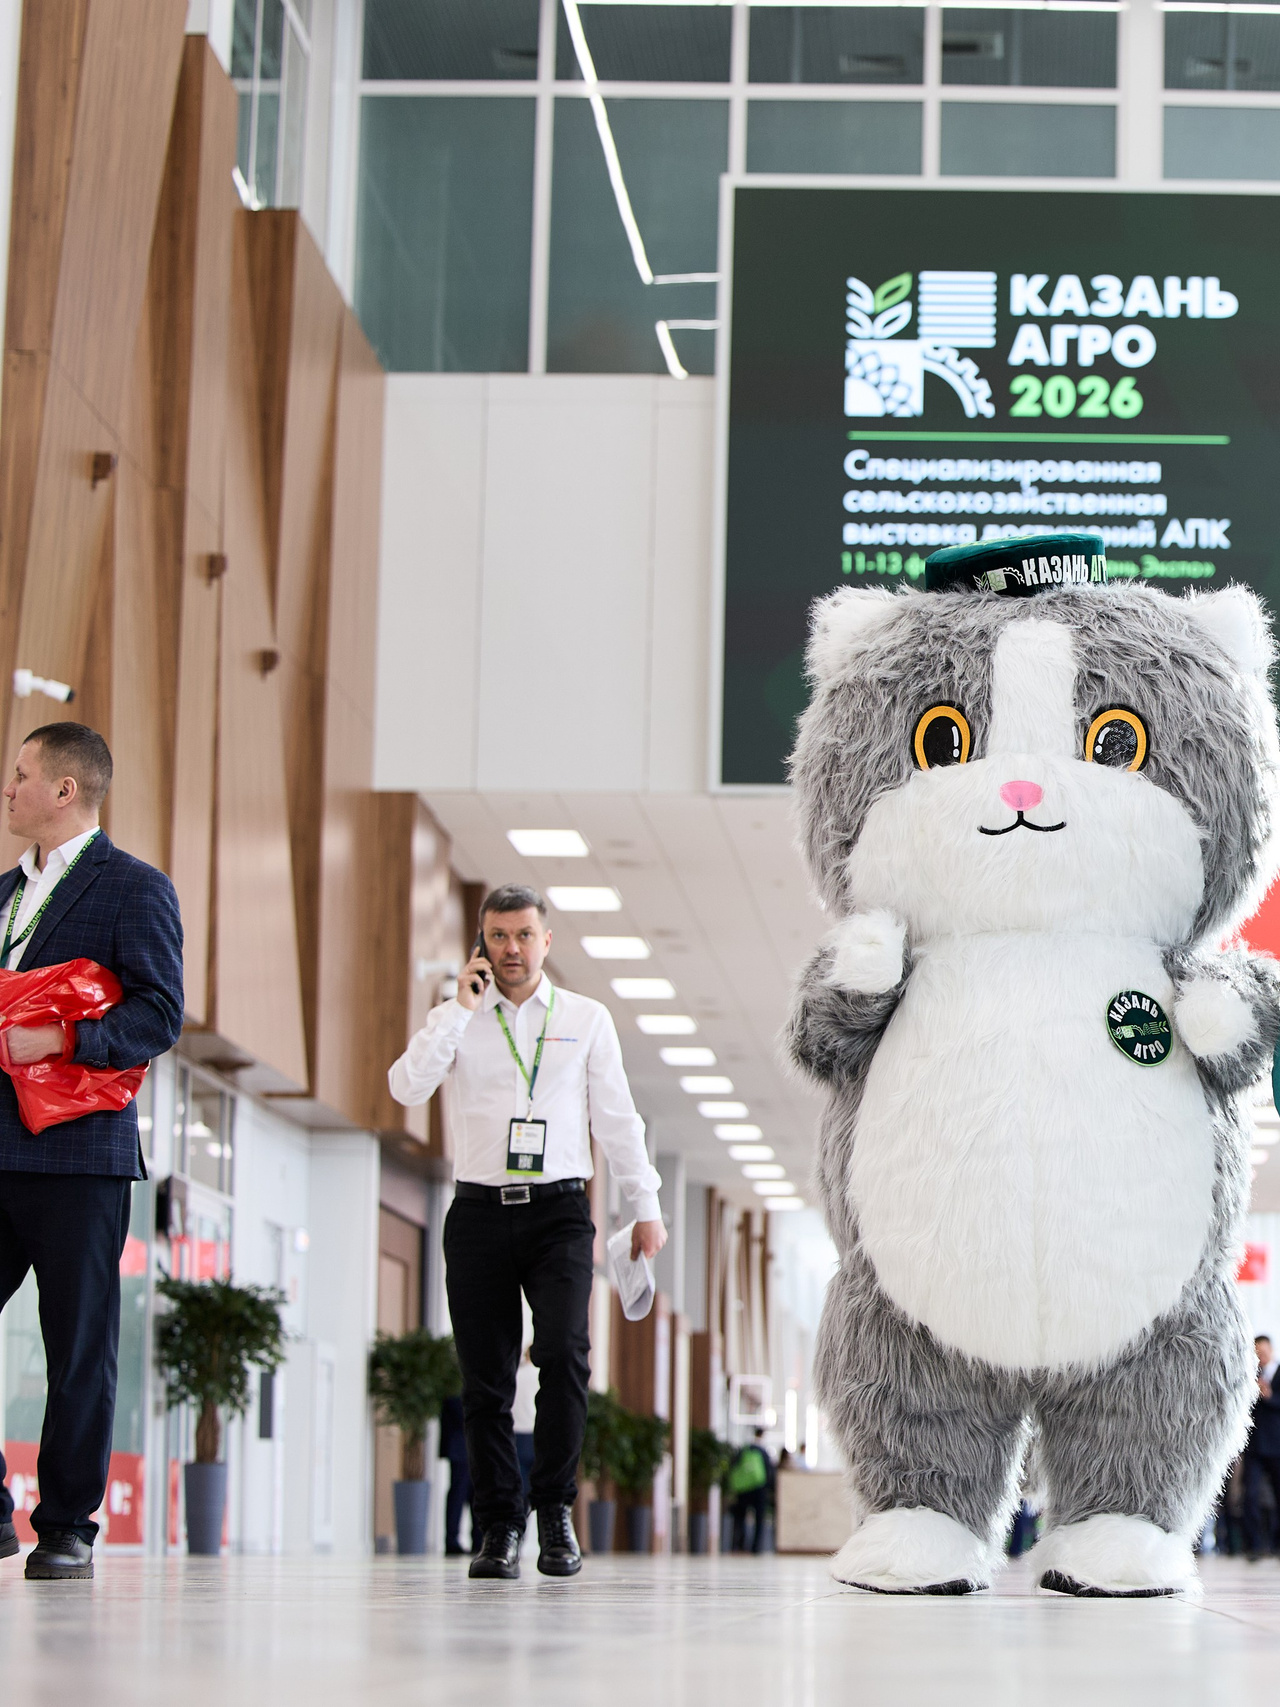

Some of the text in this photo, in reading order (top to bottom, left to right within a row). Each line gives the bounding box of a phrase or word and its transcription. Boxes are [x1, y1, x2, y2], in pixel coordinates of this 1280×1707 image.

[1009, 273, 1239, 319] КАЗАНЬ
[1008, 323, 1157, 368] АГРО
[1009, 374, 1144, 419] 2026
[843, 449, 1162, 488] Специализированная
[842, 486, 1168, 516] сельскохозяйственная
[842, 523, 977, 546] выставка
[1160, 518, 1232, 549] АПК
[841, 551, 903, 576] 11-13
[1022, 554, 1089, 587] КАЗАНЬ
[23, 895, 54, 937] КАЗАНЬ АГРО
[1109, 994, 1159, 1023] КАЗАНЬ
[1133, 1040, 1165, 1060] АГРО
